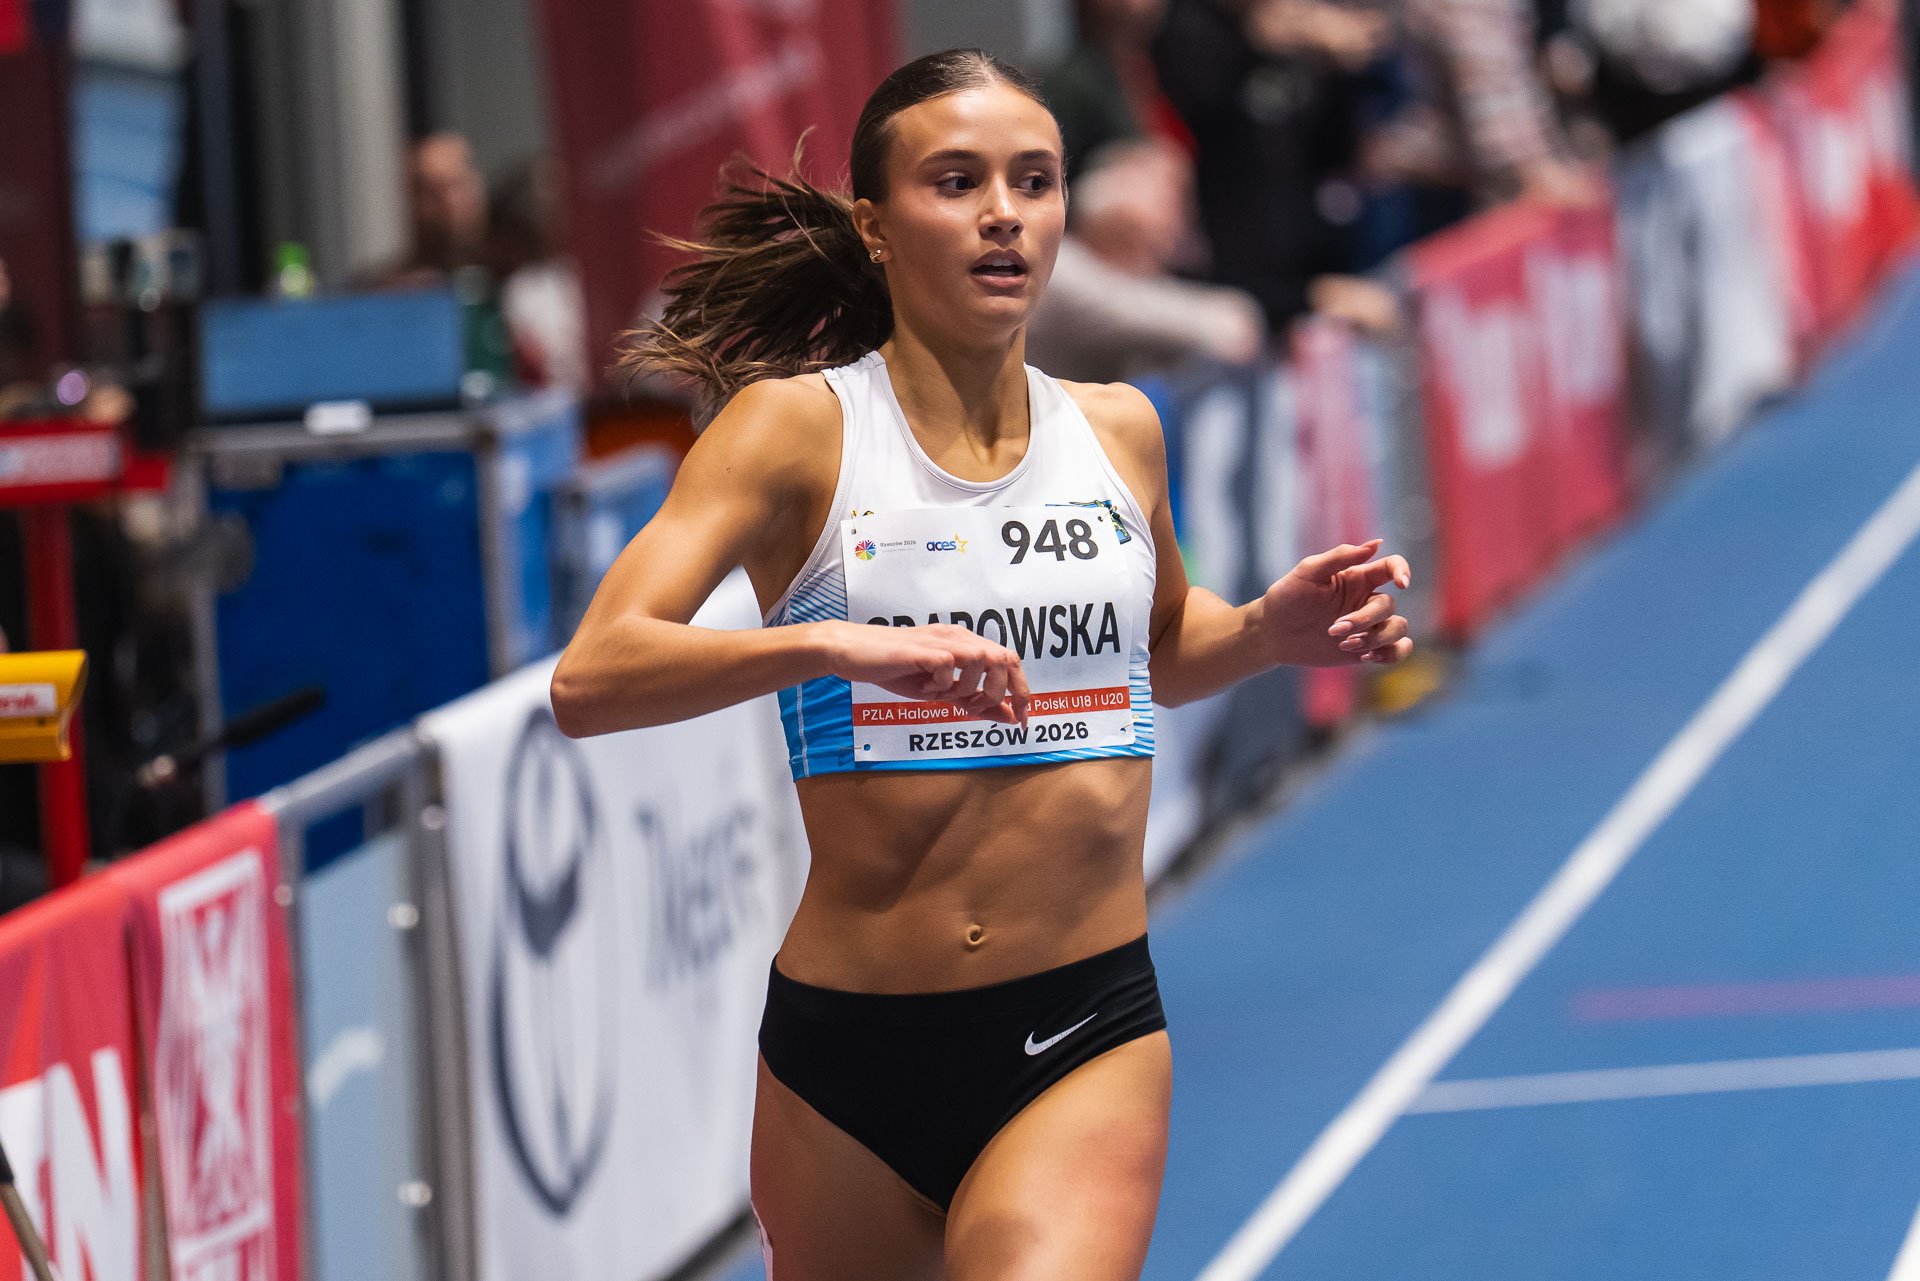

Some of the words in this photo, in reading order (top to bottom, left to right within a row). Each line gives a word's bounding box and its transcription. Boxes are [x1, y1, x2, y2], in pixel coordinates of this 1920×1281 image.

[926, 540, 957, 552] aces
[1001, 518, 1099, 565] 948
[867, 601, 1121, 661] OWSKA
[862, 708, 895, 721] PZLA
[898, 706, 950, 720] Halowe
[1034, 695, 1069, 712] Polski
[1071, 695, 1092, 708] U18
[1094, 694, 1098, 706] i
[1100, 692, 1124, 706] U20
[909, 722, 1029, 752] RZESZÓW
[1034, 721, 1089, 744] 2026
